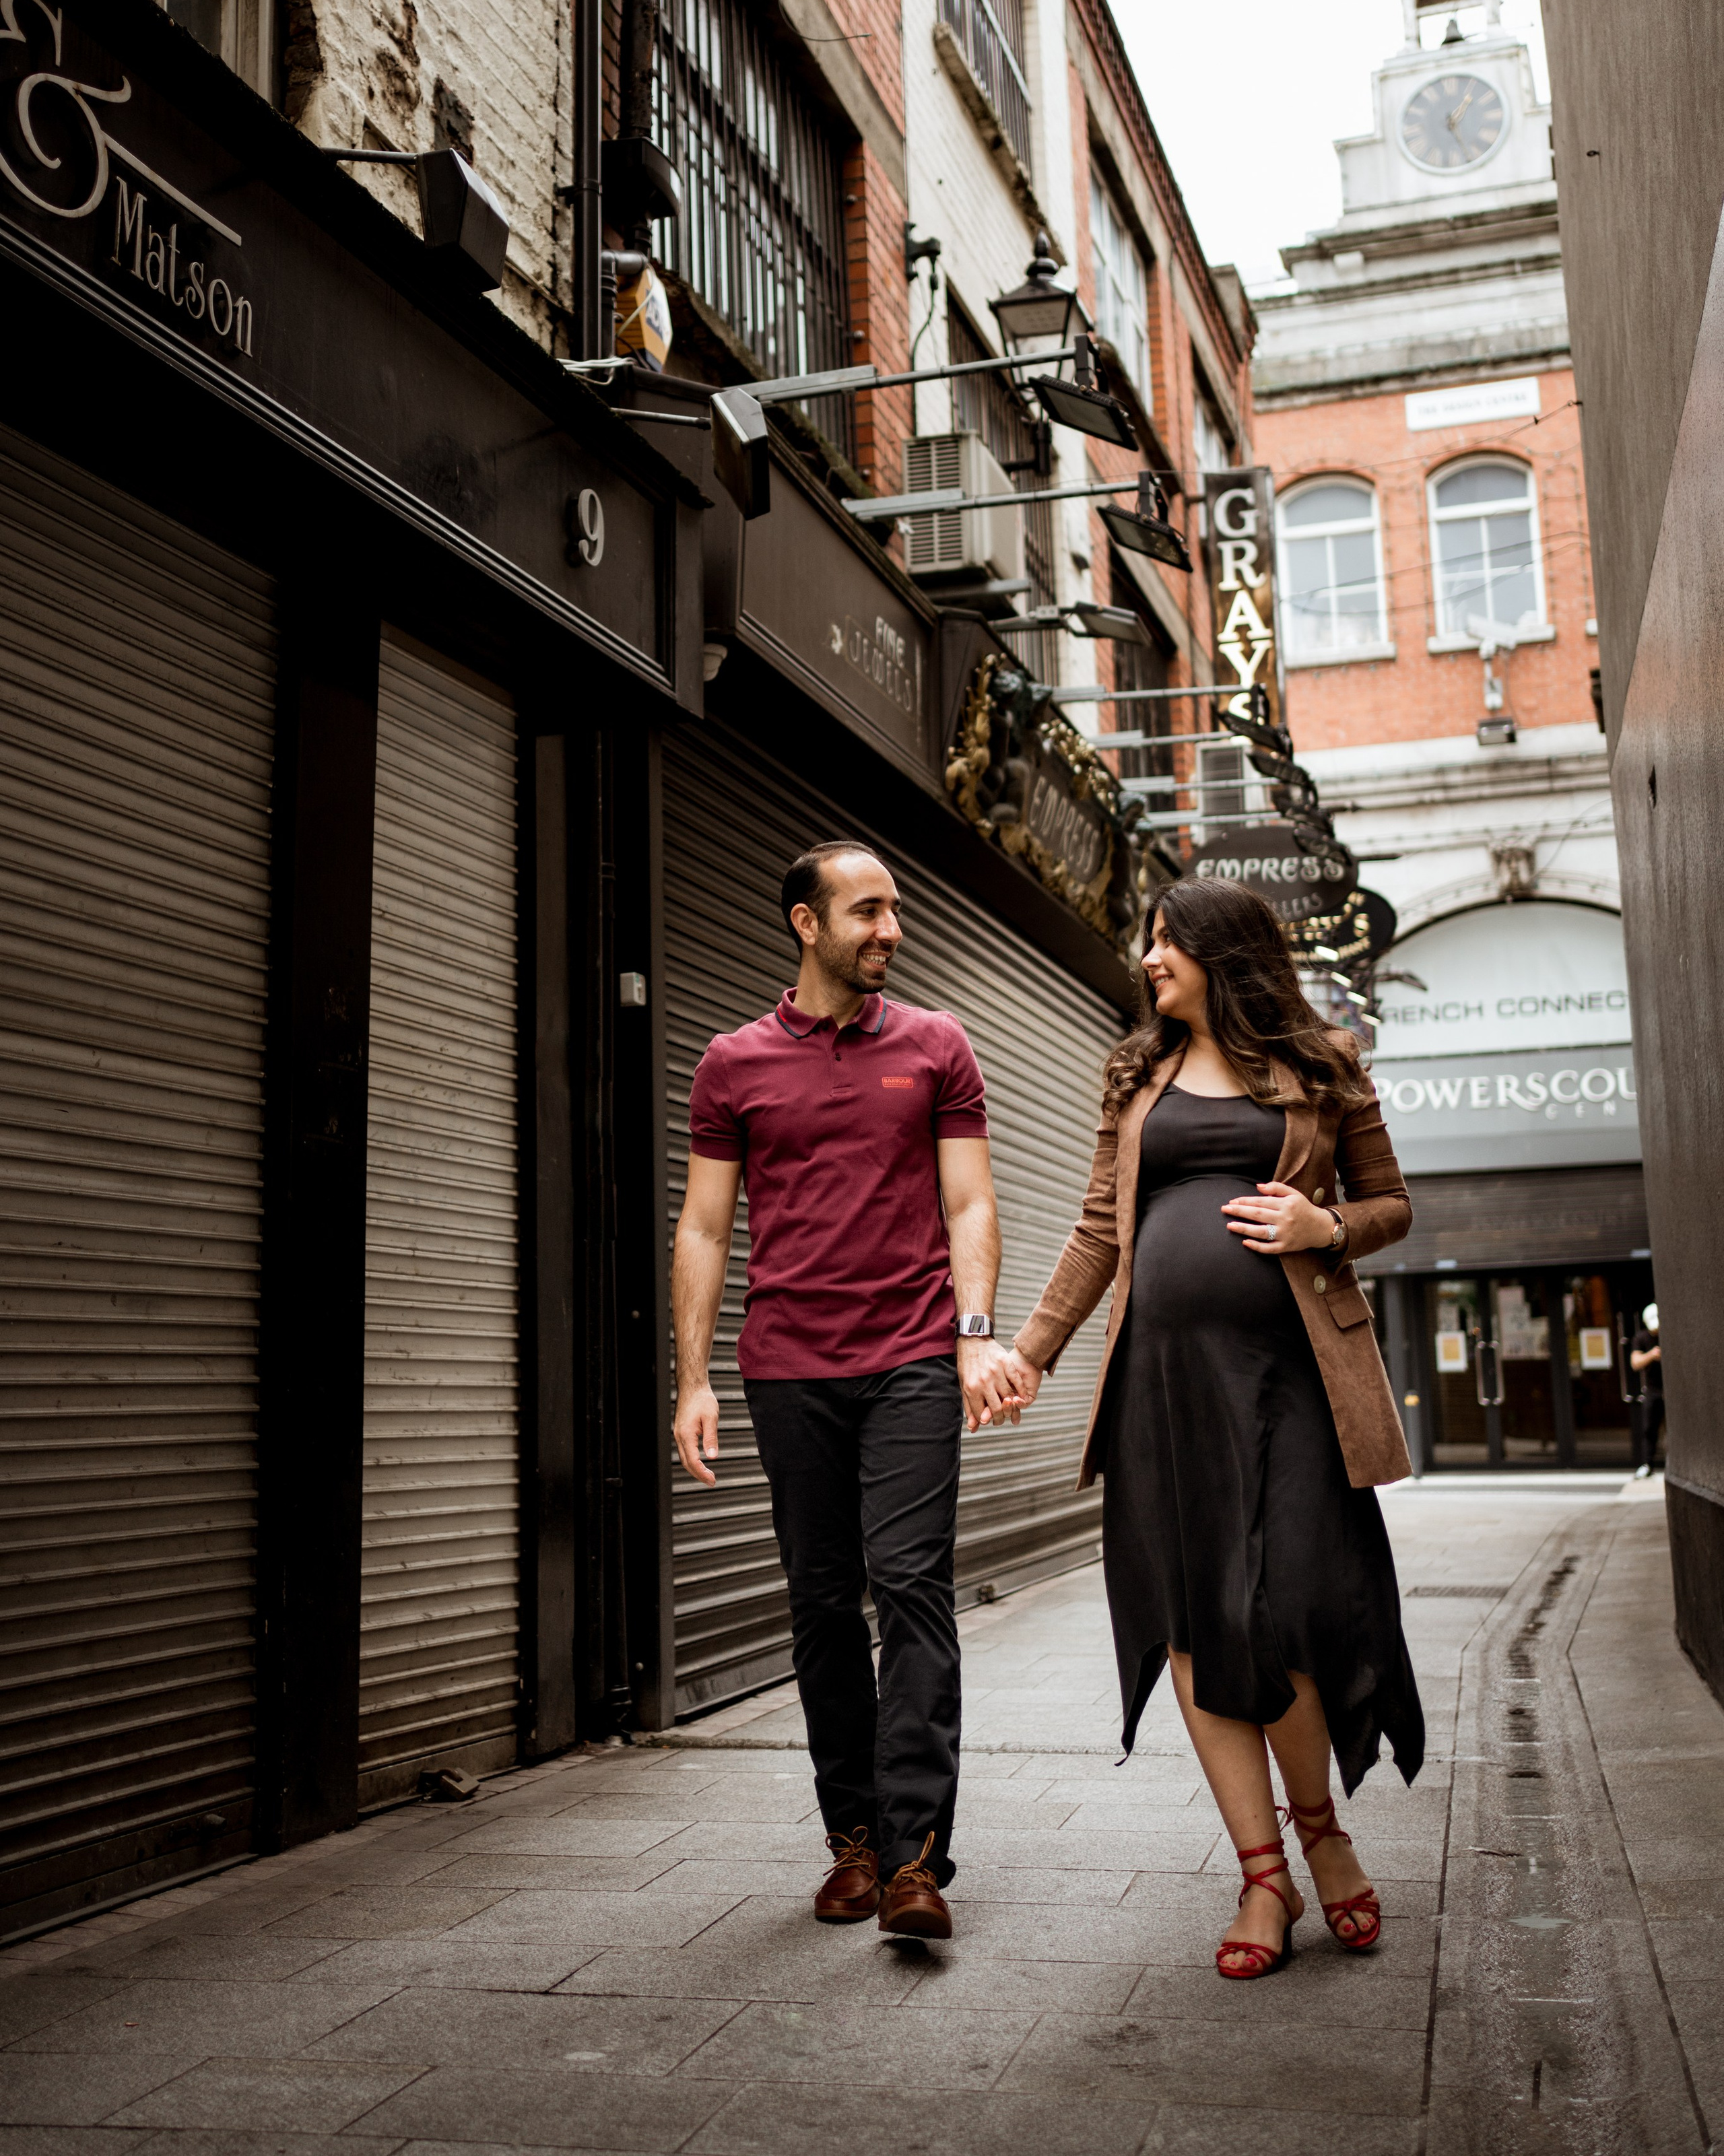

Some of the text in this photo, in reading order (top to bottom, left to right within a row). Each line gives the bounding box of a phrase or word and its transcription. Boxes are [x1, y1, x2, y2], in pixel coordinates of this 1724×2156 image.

[110, 176, 253, 358] Matson
[577, 488, 605, 566] 9
[849, 631, 913, 712] JEWELS
[876, 615, 906, 669] FINE
[1030, 776, 1100, 874] EMPRESS
[1195, 856, 1344, 883] EMPRESS
[1381, 989, 1629, 1025] RENCH CONNEC
